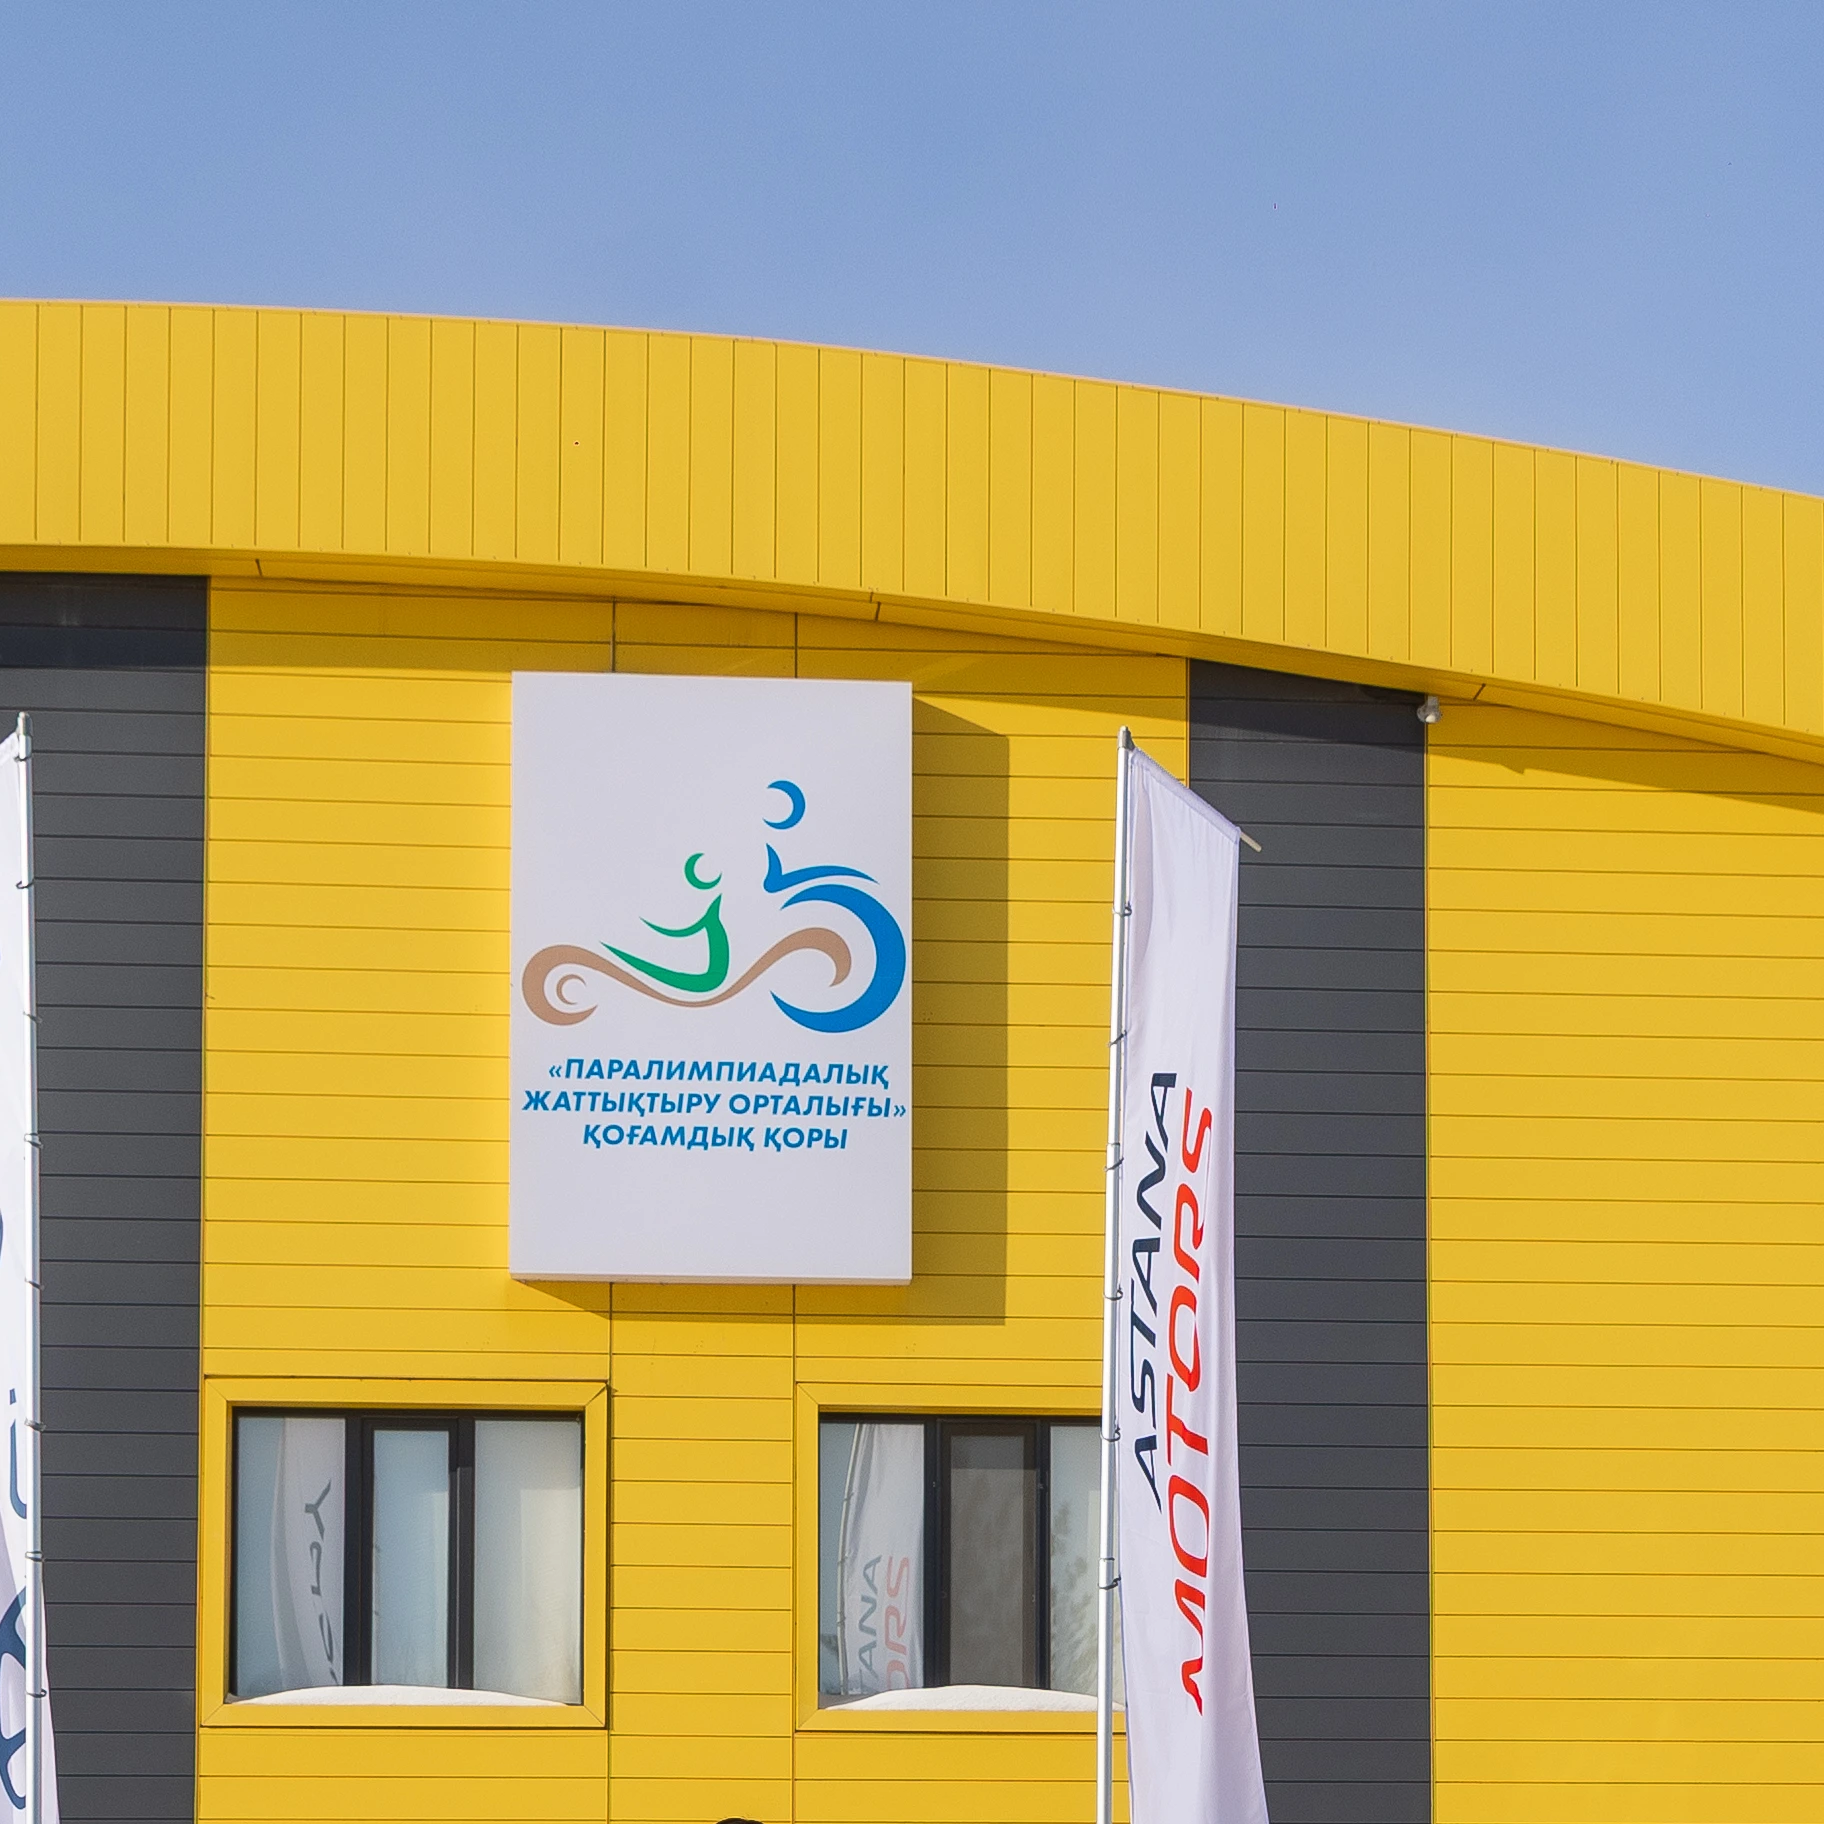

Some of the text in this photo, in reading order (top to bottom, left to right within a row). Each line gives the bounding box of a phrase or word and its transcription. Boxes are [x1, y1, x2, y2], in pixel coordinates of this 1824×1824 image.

[549, 1058, 889, 1088] «ПАРАЛИМПИАДАЛЫҚ
[522, 1090, 907, 1118] ЖАТТЫҚТЫРУ ОРТАЛЫҒЫ»
[583, 1124, 848, 1151] ҚОҒАМДЫҚ ҚОРЫ
[1130, 1072, 1177, 1513] ASTANA
[1166, 1086, 1213, 1717] MOTORS
